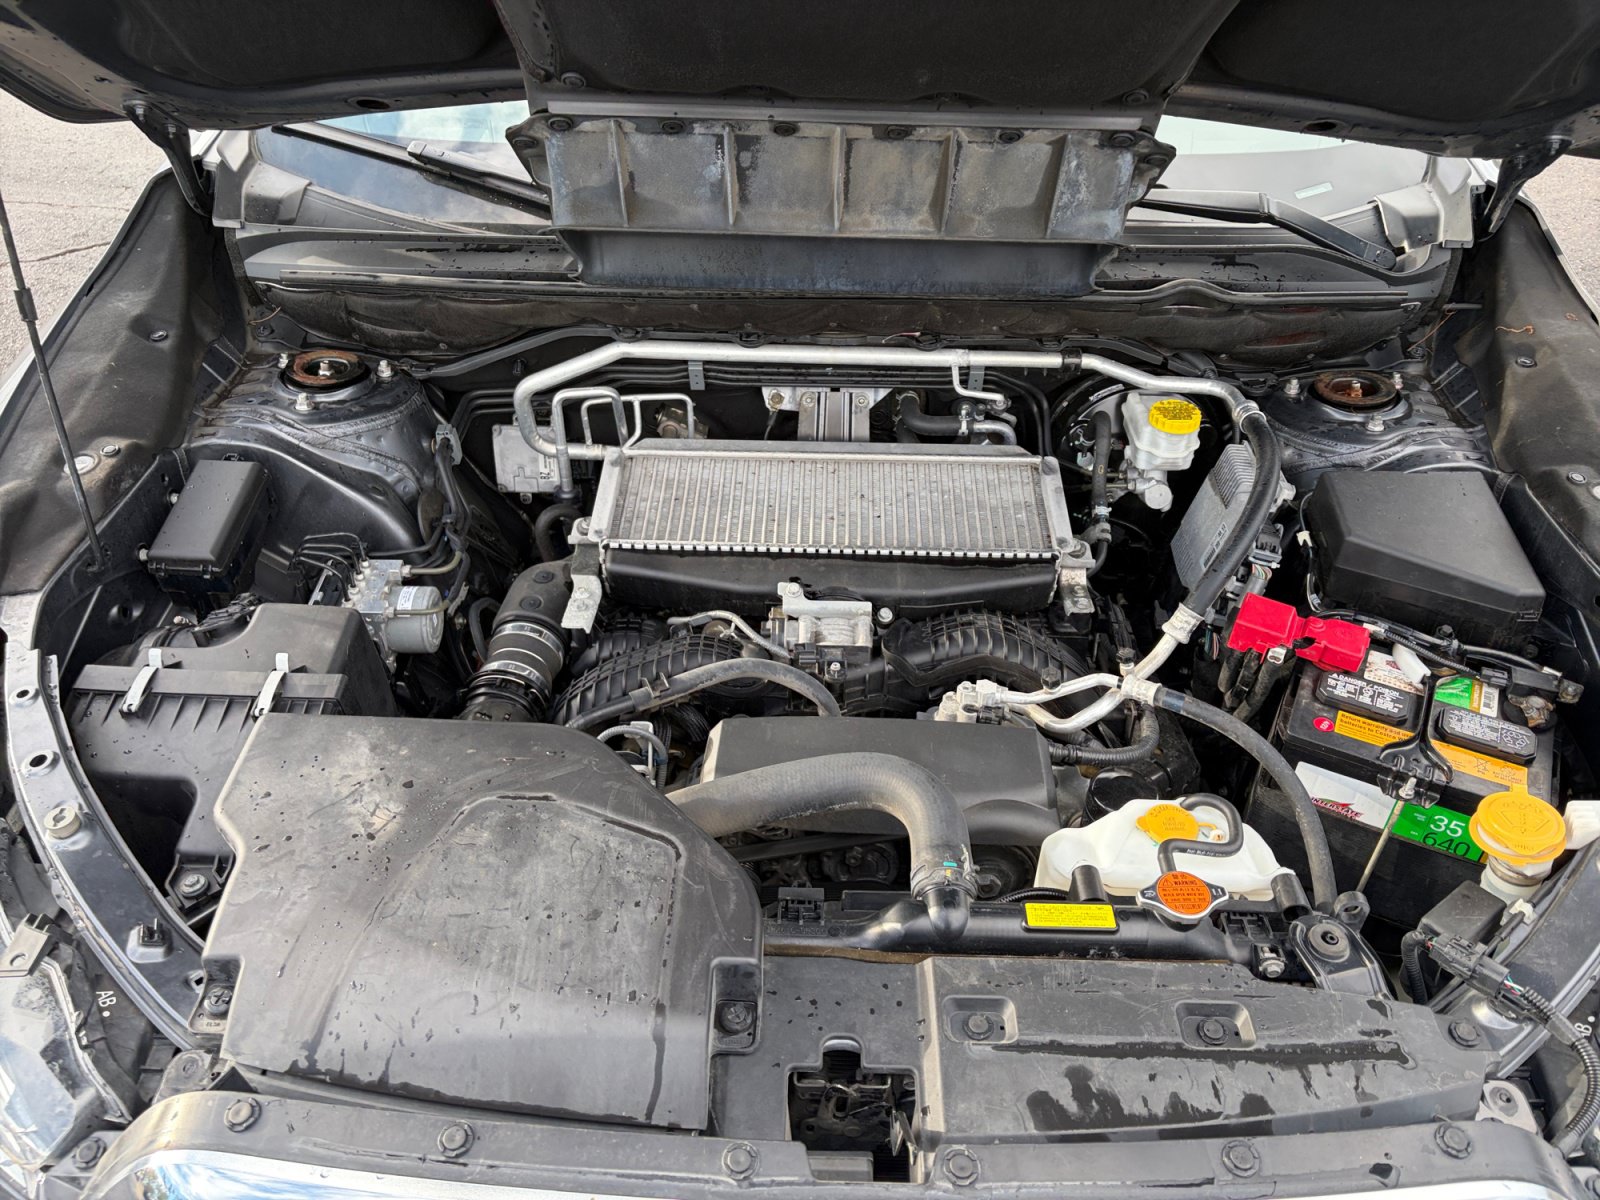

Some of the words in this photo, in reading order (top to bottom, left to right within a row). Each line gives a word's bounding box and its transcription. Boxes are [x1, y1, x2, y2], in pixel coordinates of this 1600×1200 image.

[1373, 685, 1400, 697] POISON
[1341, 713, 1361, 723] Return
[1375, 729, 1397, 740] Costco
[1429, 815, 1466, 838] 35
[1422, 832, 1471, 857] 640
[1574, 1022, 1592, 1037] B
